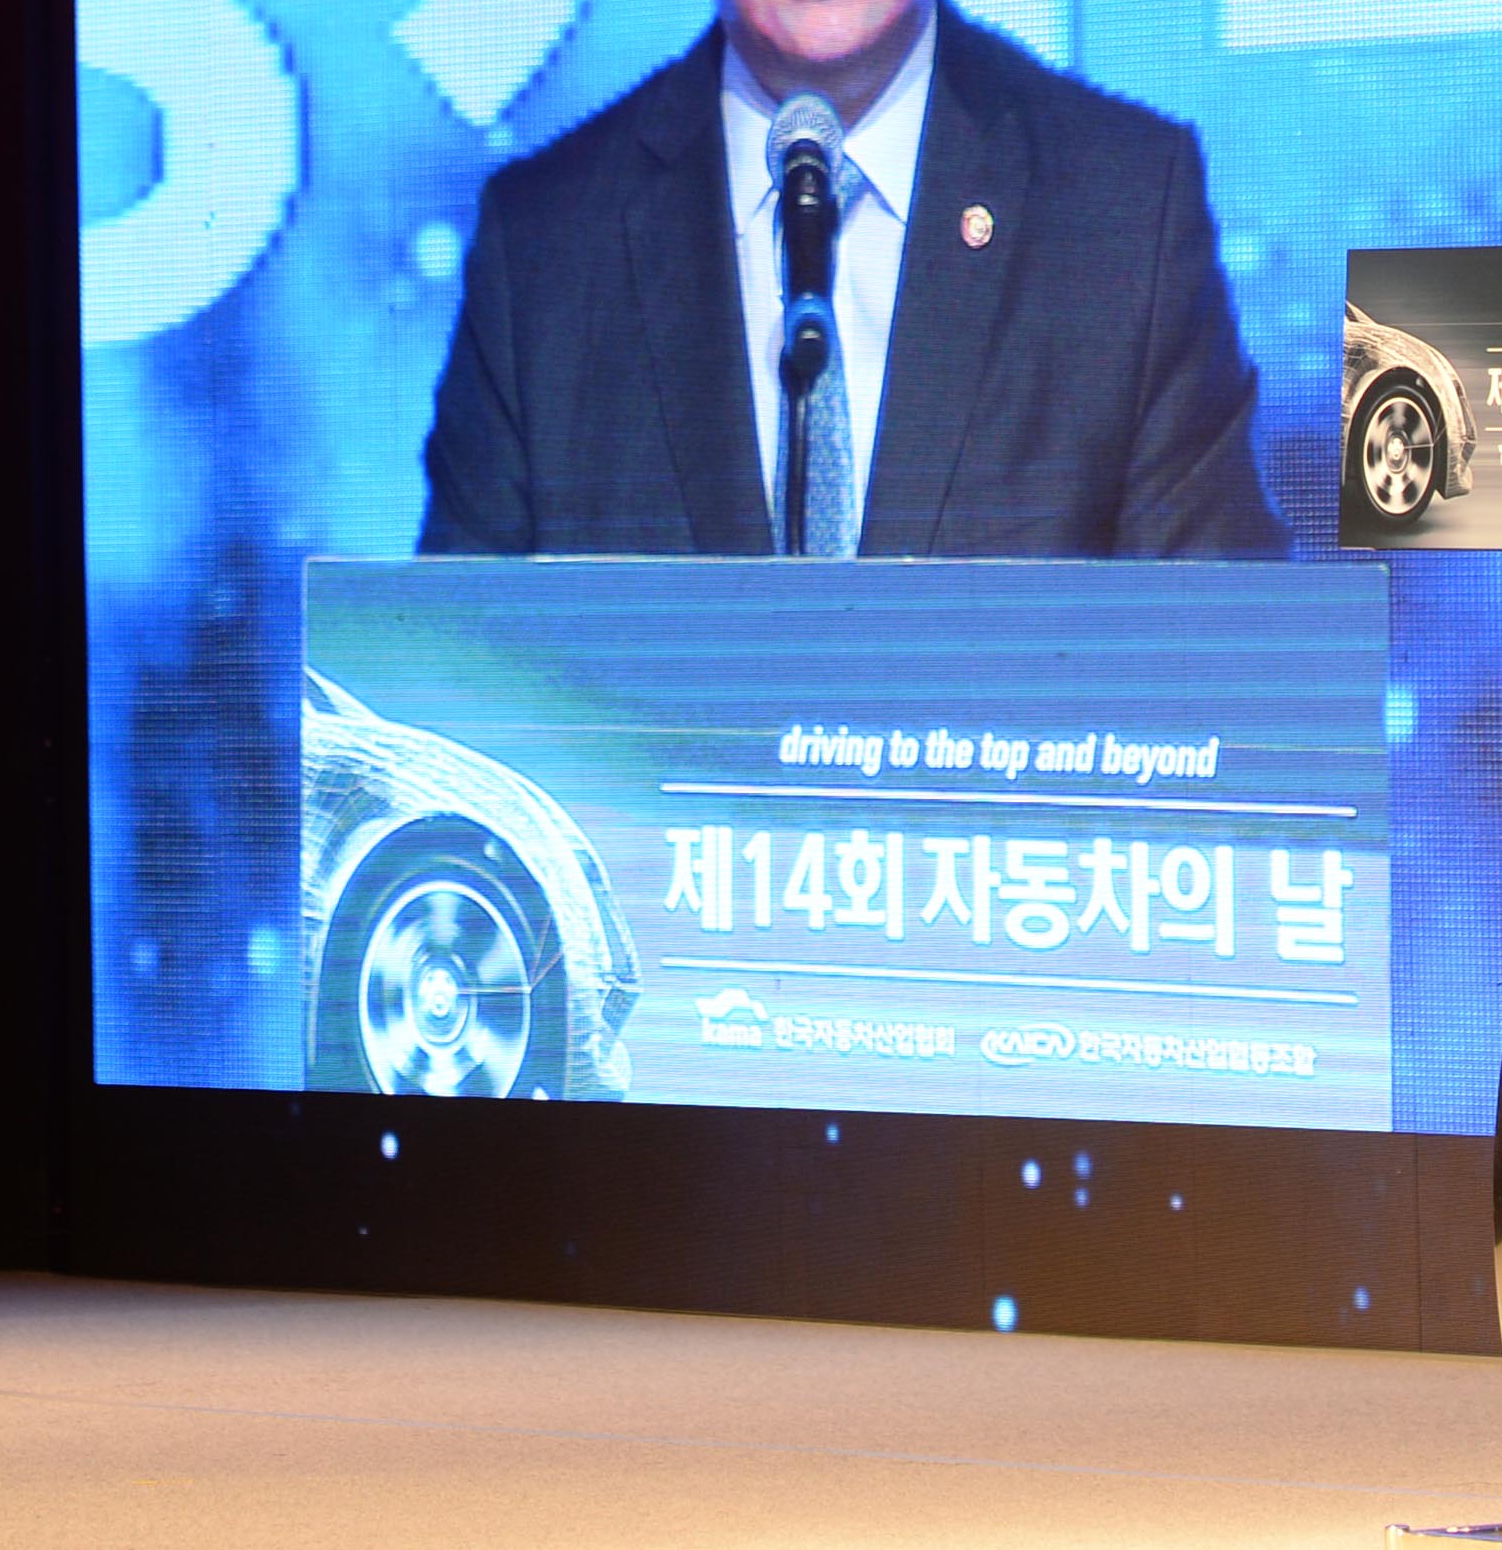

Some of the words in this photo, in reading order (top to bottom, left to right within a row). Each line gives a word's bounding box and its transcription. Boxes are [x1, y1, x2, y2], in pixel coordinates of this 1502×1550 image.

[780, 725, 883, 777] driving
[888, 729, 919, 768] to
[924, 729, 974, 769] the
[980, 733, 1029, 780] top
[1035, 733, 1098, 774] and
[1101, 734, 1220, 785] beyond
[664, 824, 903, 940] 제14회
[920, 834, 1236, 957] 자동차의
[1270, 849, 1353, 963] 날
